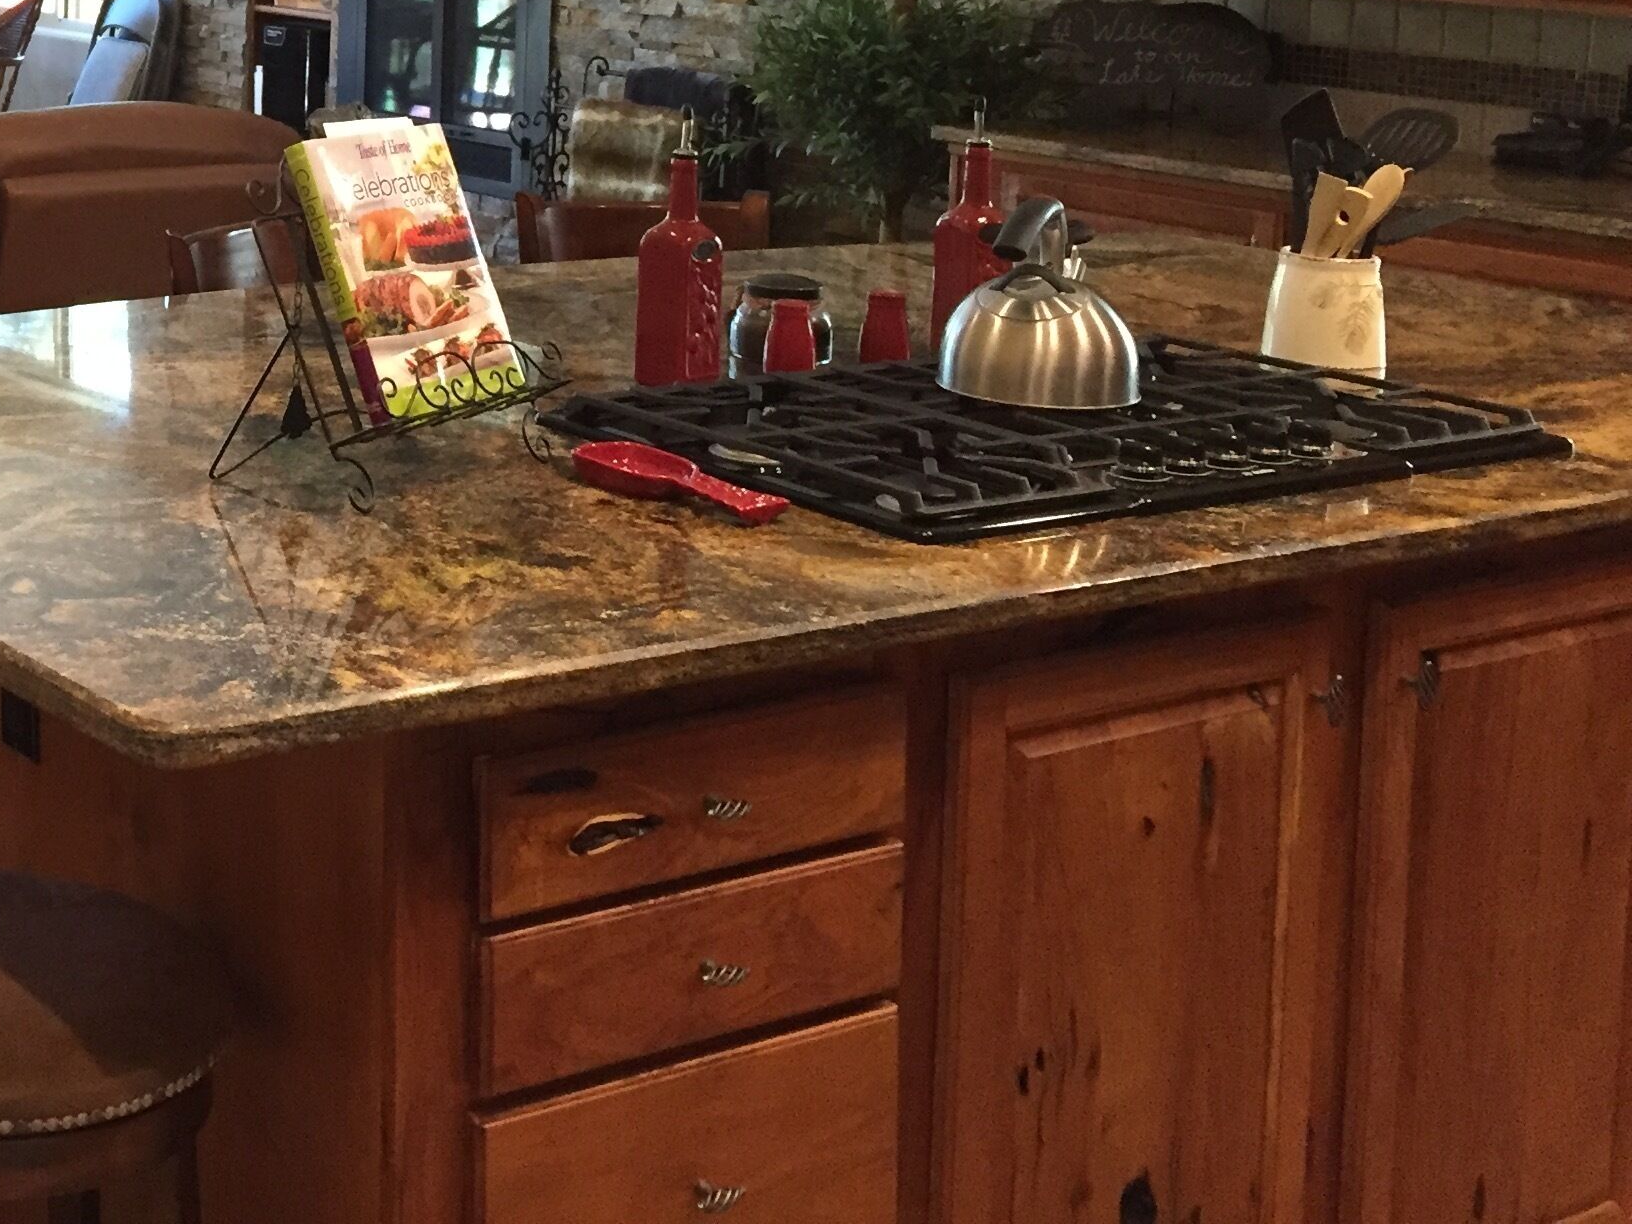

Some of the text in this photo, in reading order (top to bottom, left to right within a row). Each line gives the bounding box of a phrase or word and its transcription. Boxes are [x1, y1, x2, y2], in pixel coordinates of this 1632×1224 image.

[1084, 7, 1255, 55] Welcome
[1134, 48, 1157, 62] to
[1099, 58, 1165, 85] Lake
[356, 139, 411, 160] Taste of Home
[352, 170, 450, 201] elebrations
[294, 167, 345, 307] Celebrations
